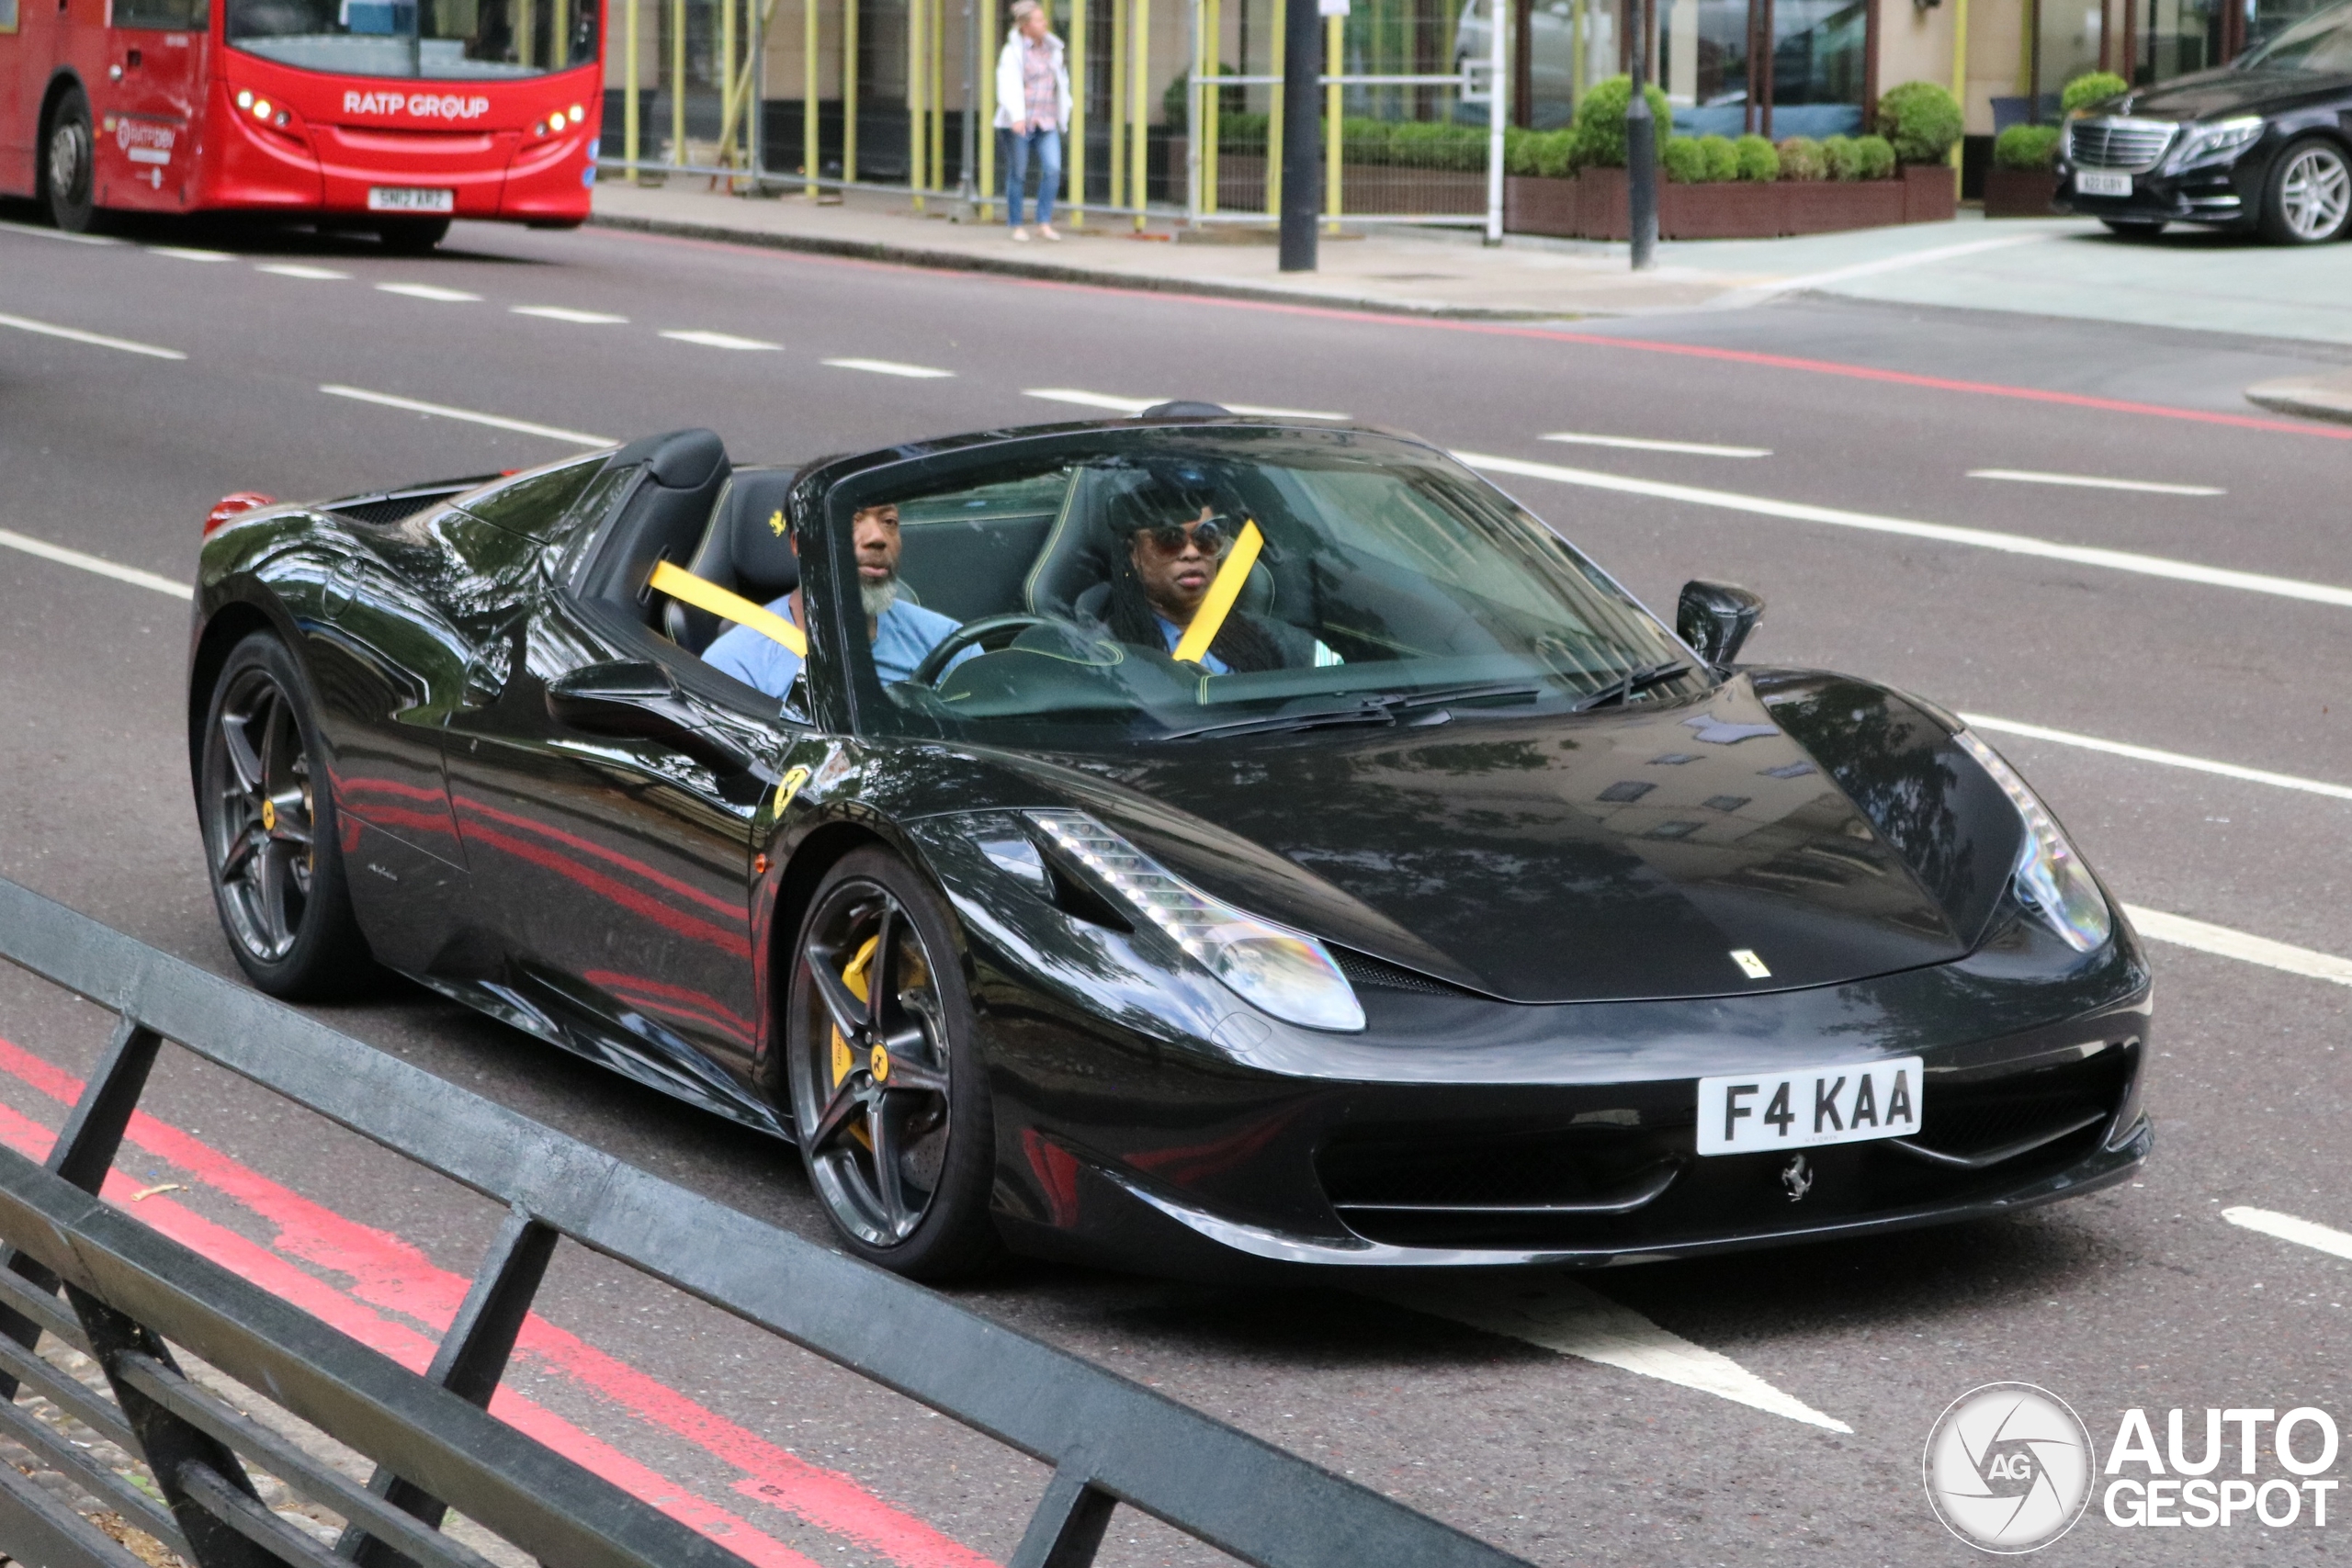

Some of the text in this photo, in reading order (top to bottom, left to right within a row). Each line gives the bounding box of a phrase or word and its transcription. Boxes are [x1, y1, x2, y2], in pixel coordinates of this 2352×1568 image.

[343, 90, 490, 120] RATP GROUP
[1724, 1069, 1914, 1142] F4 KAA
